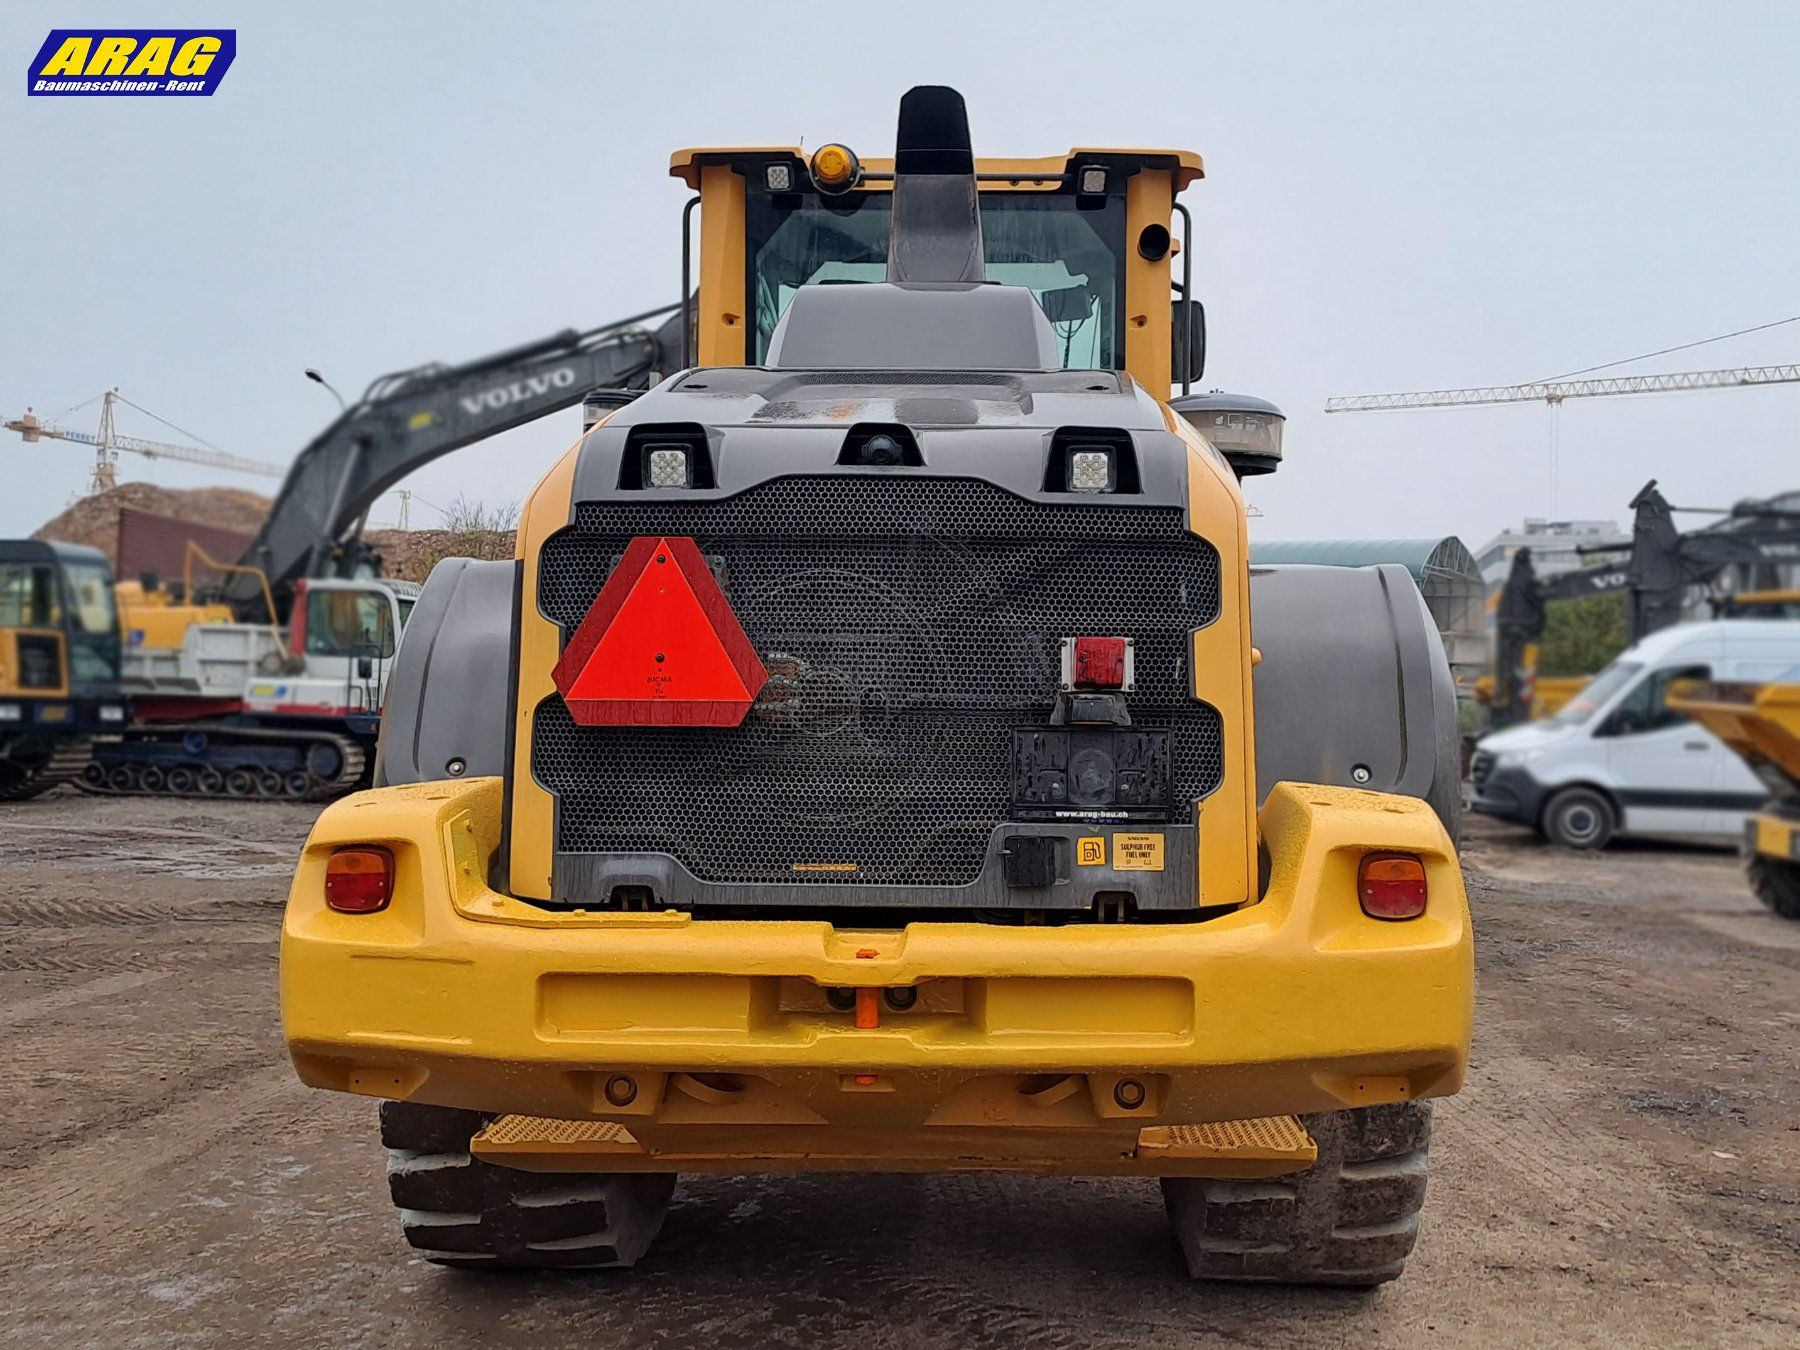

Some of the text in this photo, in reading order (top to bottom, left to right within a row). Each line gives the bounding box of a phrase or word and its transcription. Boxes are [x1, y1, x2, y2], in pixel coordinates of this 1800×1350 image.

[460, 367, 575, 415] VOLVO
[1055, 810, 1128, 818] www.arag-bau.ch
[1125, 851, 1151, 859] FUEL ONLY
